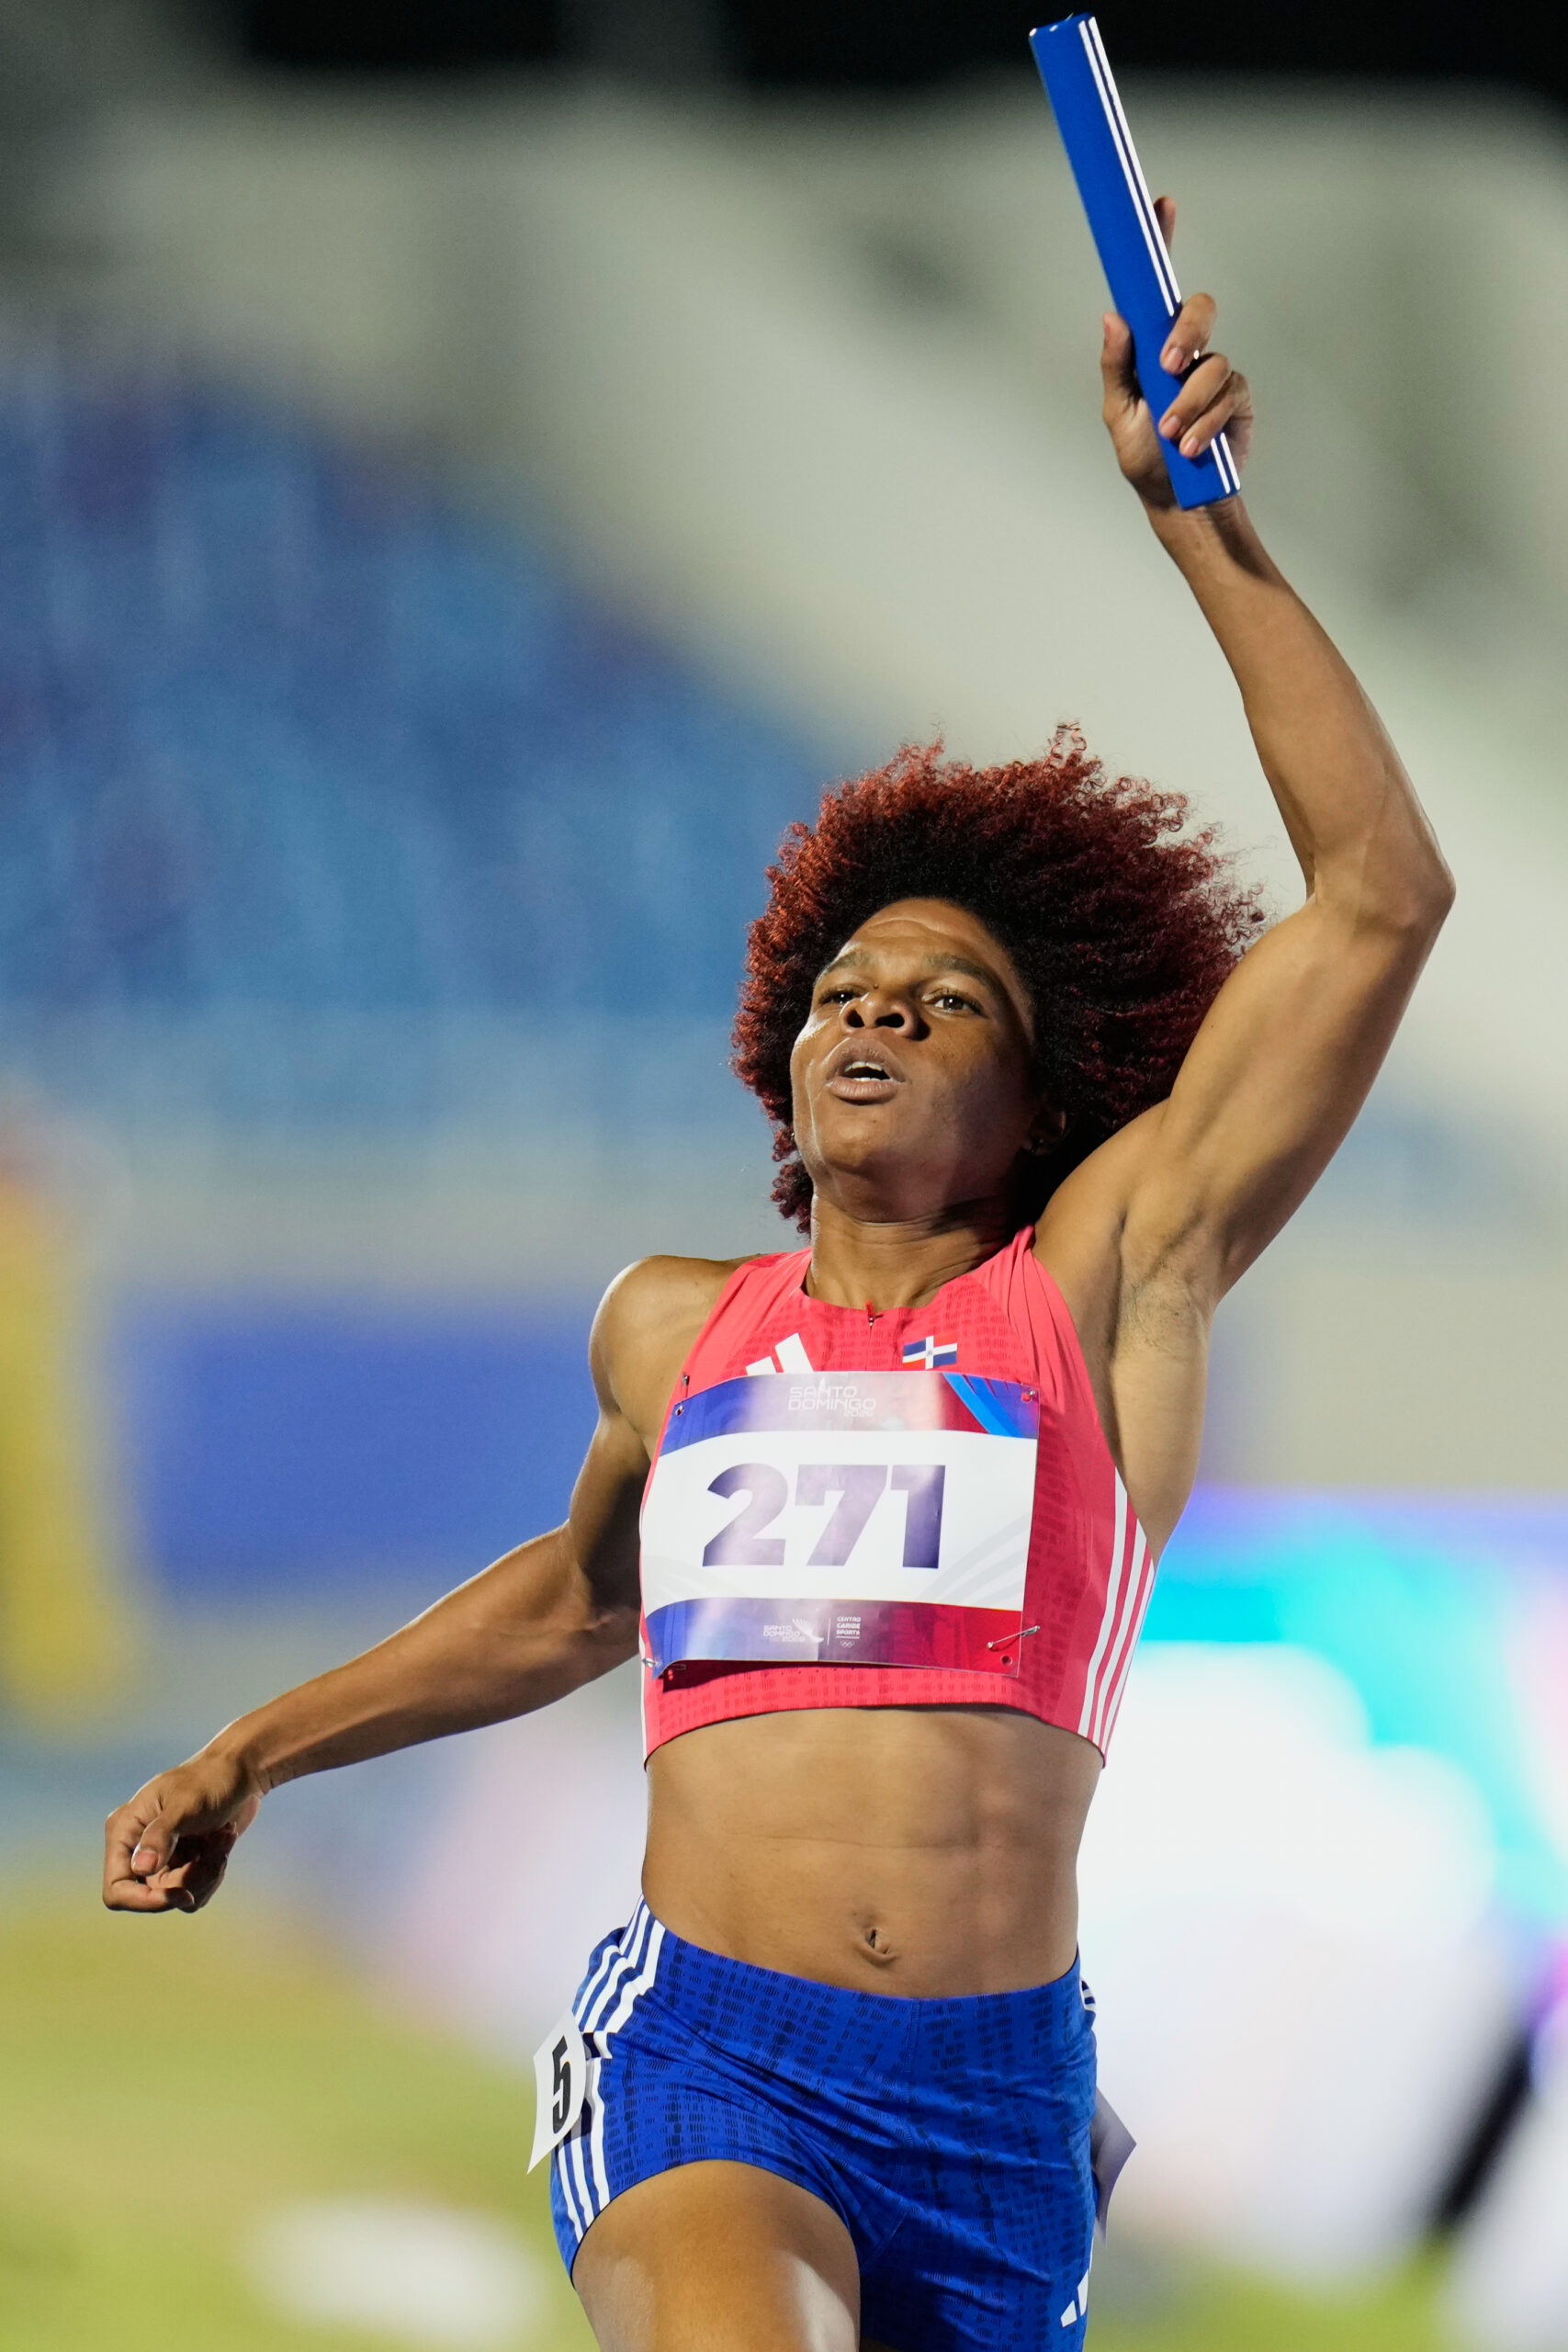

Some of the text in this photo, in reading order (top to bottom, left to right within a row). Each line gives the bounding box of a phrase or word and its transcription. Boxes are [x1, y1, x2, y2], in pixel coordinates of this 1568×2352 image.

[788, 1397, 876, 1410] DOMINGO
[790, 1385, 857, 1397] SANTO
[702, 1463, 946, 1569] 271
[552, 2035, 571, 2134] 5
